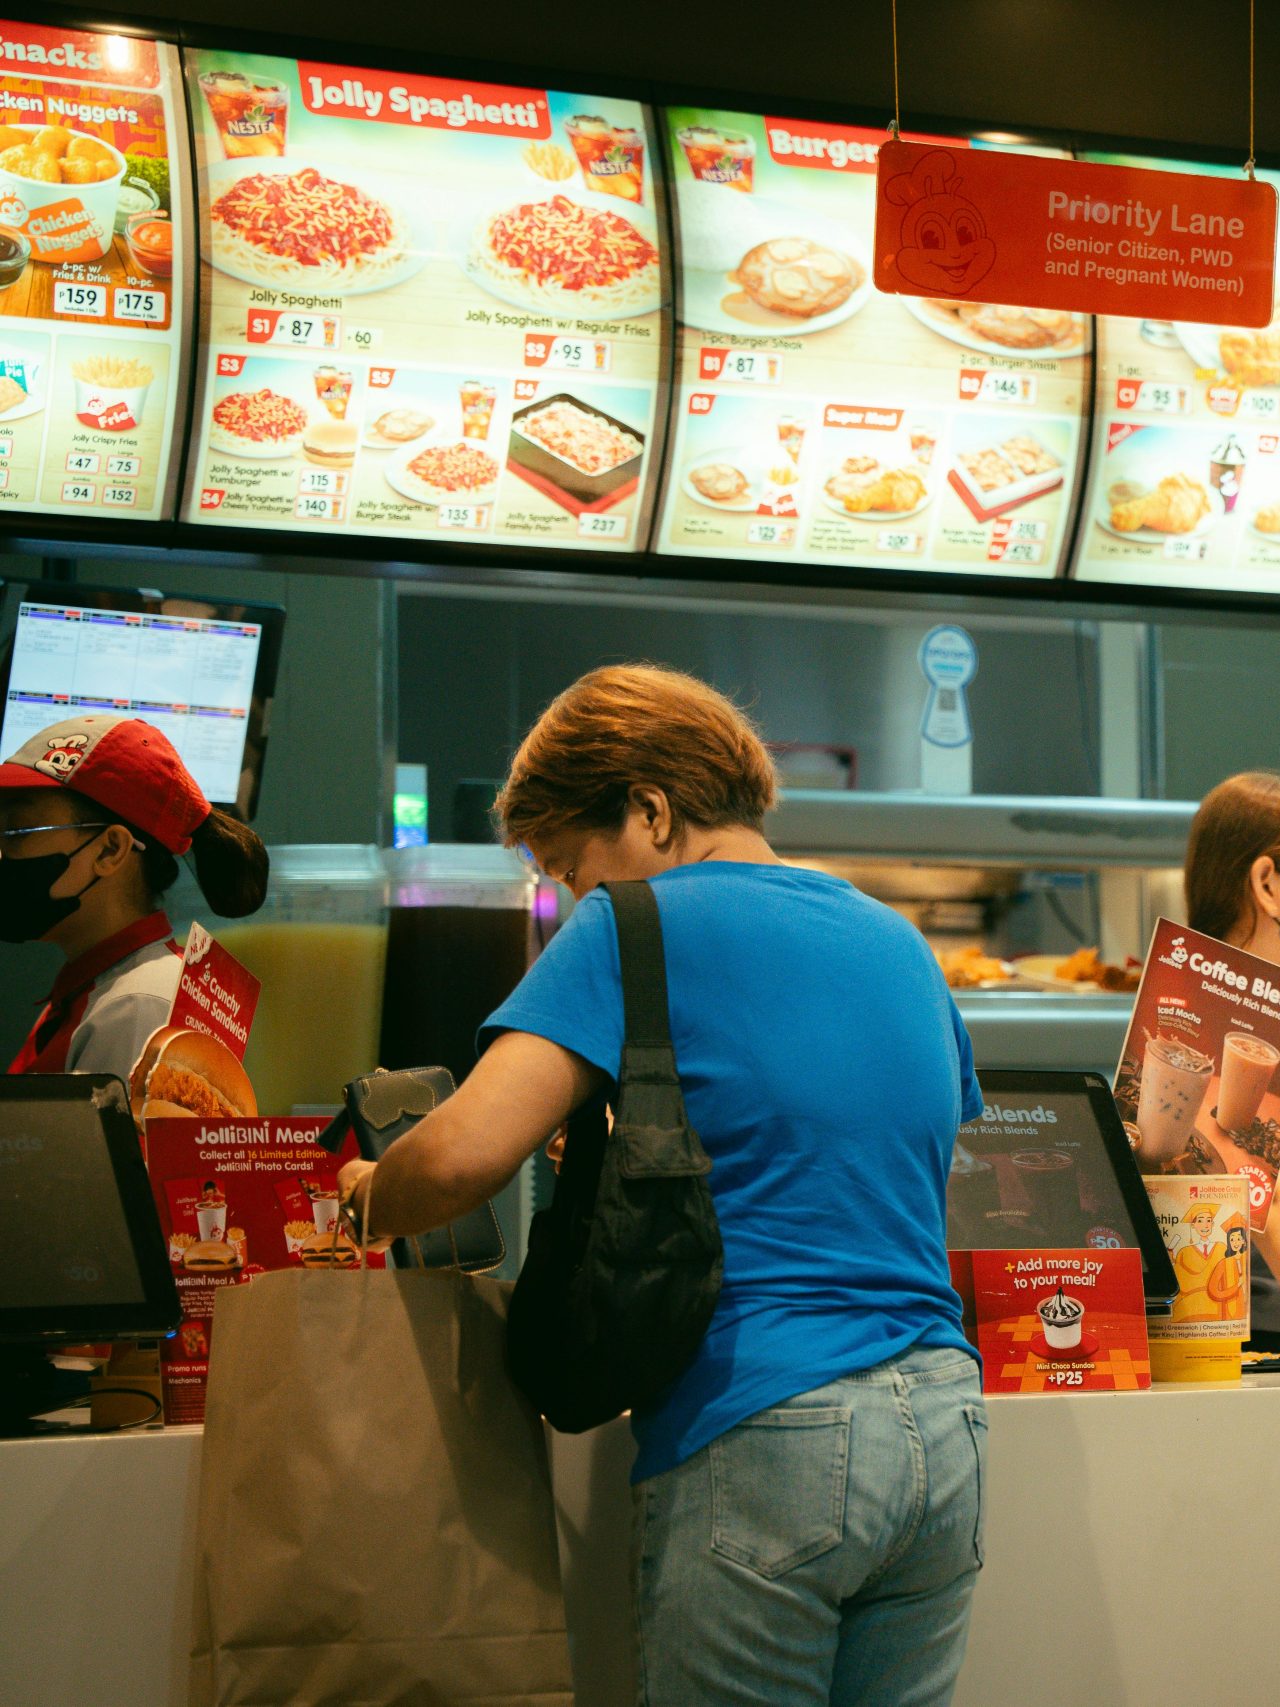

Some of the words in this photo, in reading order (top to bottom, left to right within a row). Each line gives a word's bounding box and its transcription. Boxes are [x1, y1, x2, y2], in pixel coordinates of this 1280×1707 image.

[48, 97, 138, 124] Nuggets
[308, 76, 383, 117] Jolly
[389, 87, 538, 129] Spaghetti
[769, 128, 880, 168] Burger
[589, 160, 637, 176] NESTEA
[28, 209, 94, 236] Chicken
[1048, 190, 1162, 236] Priority
[1171, 204, 1245, 239] Lane
[36, 223, 105, 254] Nuggets
[1045, 232, 1112, 255] (Senior
[1117, 239, 1186, 266] Citizen,
[1190, 247, 1233, 268] PWD
[62, 261, 86, 274] 6-pc.
[88, 264, 102, 273] w/
[53, 269, 75, 280] Fries
[77, 271, 85, 281] &
[87, 272, 112, 284] Drink
[126, 276, 155, 289] 10-pc.
[1044, 258, 1080, 277] and
[1084, 261, 1168, 286] Pregnant
[1171, 270, 1245, 297] Women)
[249, 290, 277, 305] Jolly
[281, 292, 343, 310] Spaghetti
[291, 320, 313, 337] 87
[465, 310, 491, 324] Jolly
[495, 312, 553, 328] Spaghetti
[576, 320, 620, 335] Regular
[624, 323, 651, 337] Fries
[562, 345, 582, 360] 95
[72, 434, 90, 444] Jolly
[92, 436, 117, 446] Crispy
[120, 438, 138, 447] Fries
[75, 458, 92, 468] 47
[117, 461, 132, 472] 75
[72, 487, 89, 498] 94
[111, 490, 133, 501] 152
[1189, 952, 1249, 991] Coffee
[209, 977, 241, 1018] Crunchy
[1201, 980, 1242, 1006] Deliciously
[1242, 997, 1260, 1011] Rich
[181, 974, 211, 1012] Chicken
[211, 1001, 248, 1045] Sandwich
[1157, 1006, 1175, 1016] Iced
[1175, 1008, 1202, 1025] Mocha
[981, 1104, 1058, 1124] Blends
[980, 1124, 1003, 1135] Rich
[1004, 1126, 1039, 1136] Blends
[200, 1150, 232, 1160] Collect
[234, 1150, 245, 1160] all
[248, 1150, 258, 1160] 16
[259, 1150, 294, 1160] Limited
[296, 1149, 327, 1159] Edition
[255, 1162, 282, 1171] Photo
[284, 1161, 314, 1171] Cards!
[1239, 1165, 1269, 1182] STARTS
[1199, 1186, 1225, 1194] Jollibee
[1046, 1259, 1081, 1269] more
[1081, 1258, 1103, 1275] joy
[207, 1277, 228, 1286] Meal
[228, 1278, 236, 1286] A
[1013, 1277, 1028, 1289] to
[1029, 1274, 1059, 1290] your
[1061, 1273, 1096, 1287] meal!
[1178, 1331, 1208, 1339] Highlands
[168, 1365, 191, 1373] Promo
[1036, 1362, 1051, 1370] Mini
[1051, 1362, 1071, 1370] Choco
[1071, 1361, 1095, 1369] Sundae
[168, 1376, 202, 1385] Mechanics
